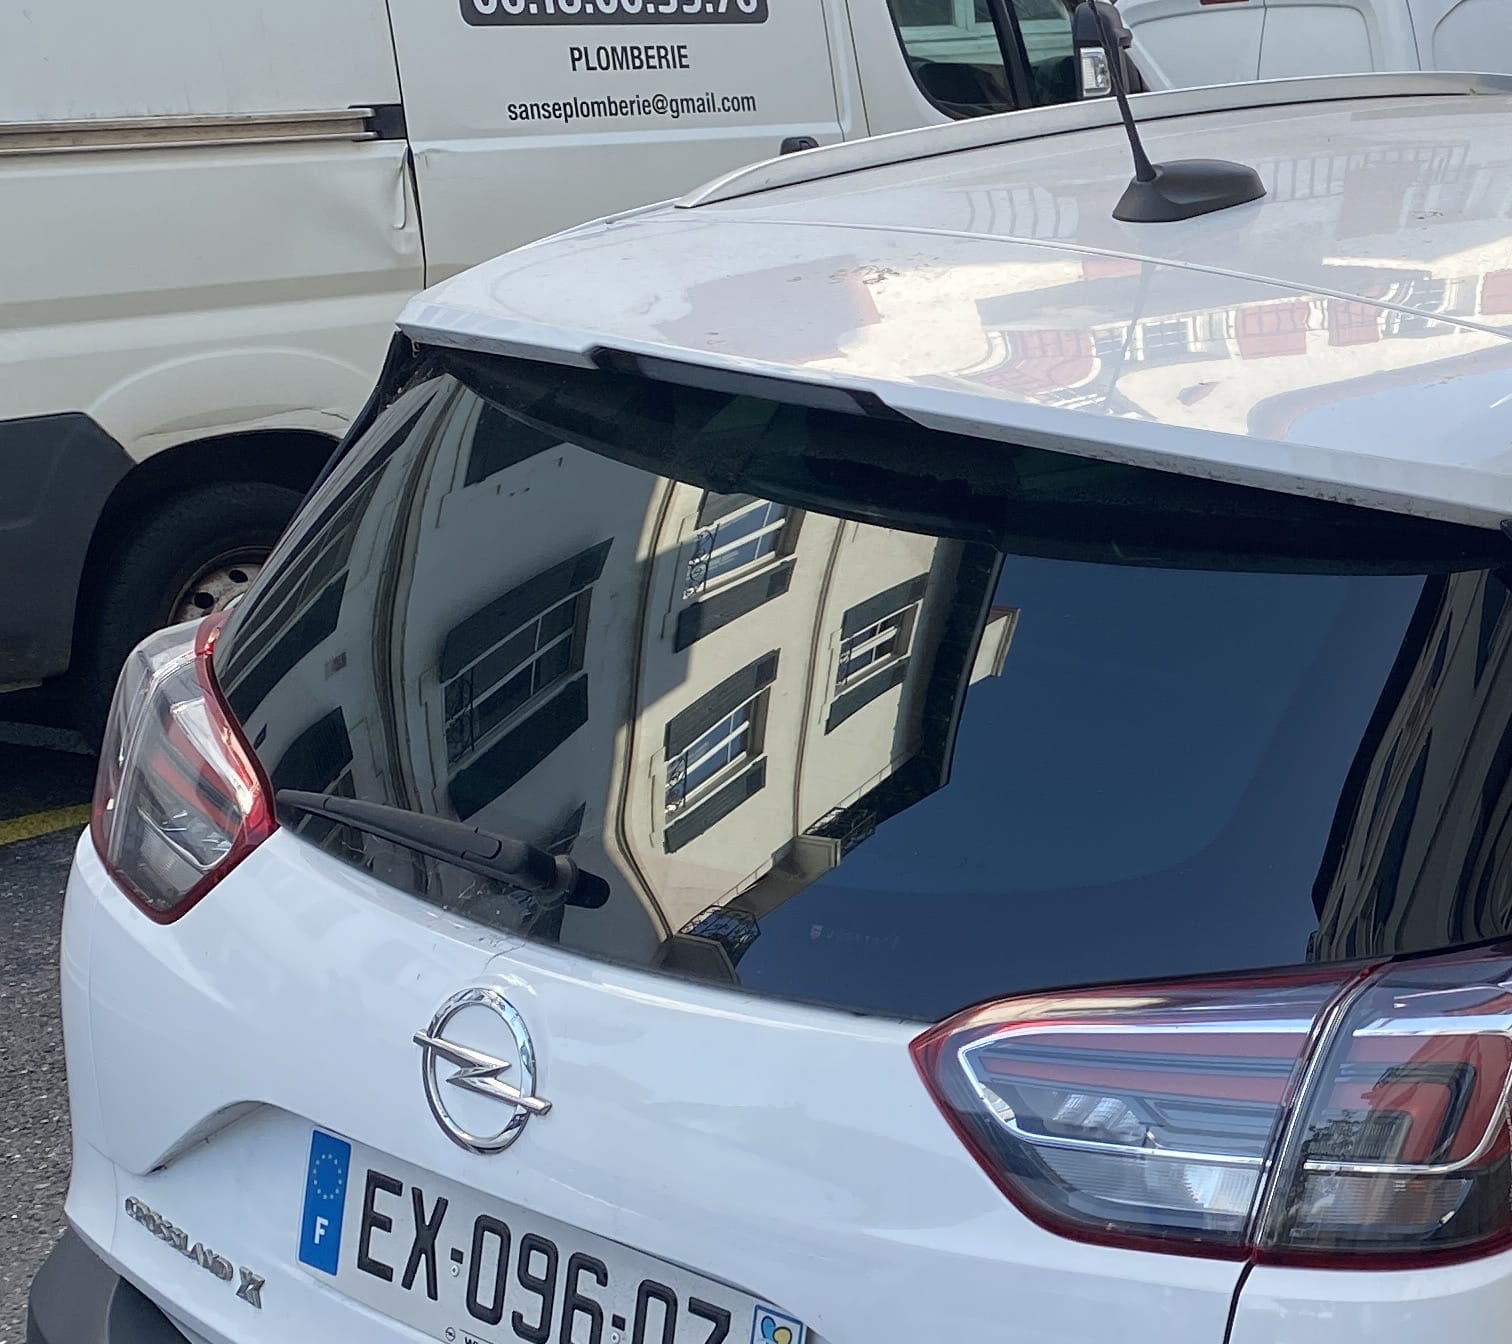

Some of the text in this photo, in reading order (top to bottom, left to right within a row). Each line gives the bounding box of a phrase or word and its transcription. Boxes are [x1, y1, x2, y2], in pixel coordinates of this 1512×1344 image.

[569, 45, 690, 71] PLOMBERIE
[507, 93, 757, 123] sanseplomberie@gmail.com
[314, 1216, 329, 1245] F
[235, 1265, 266, 1309] X
